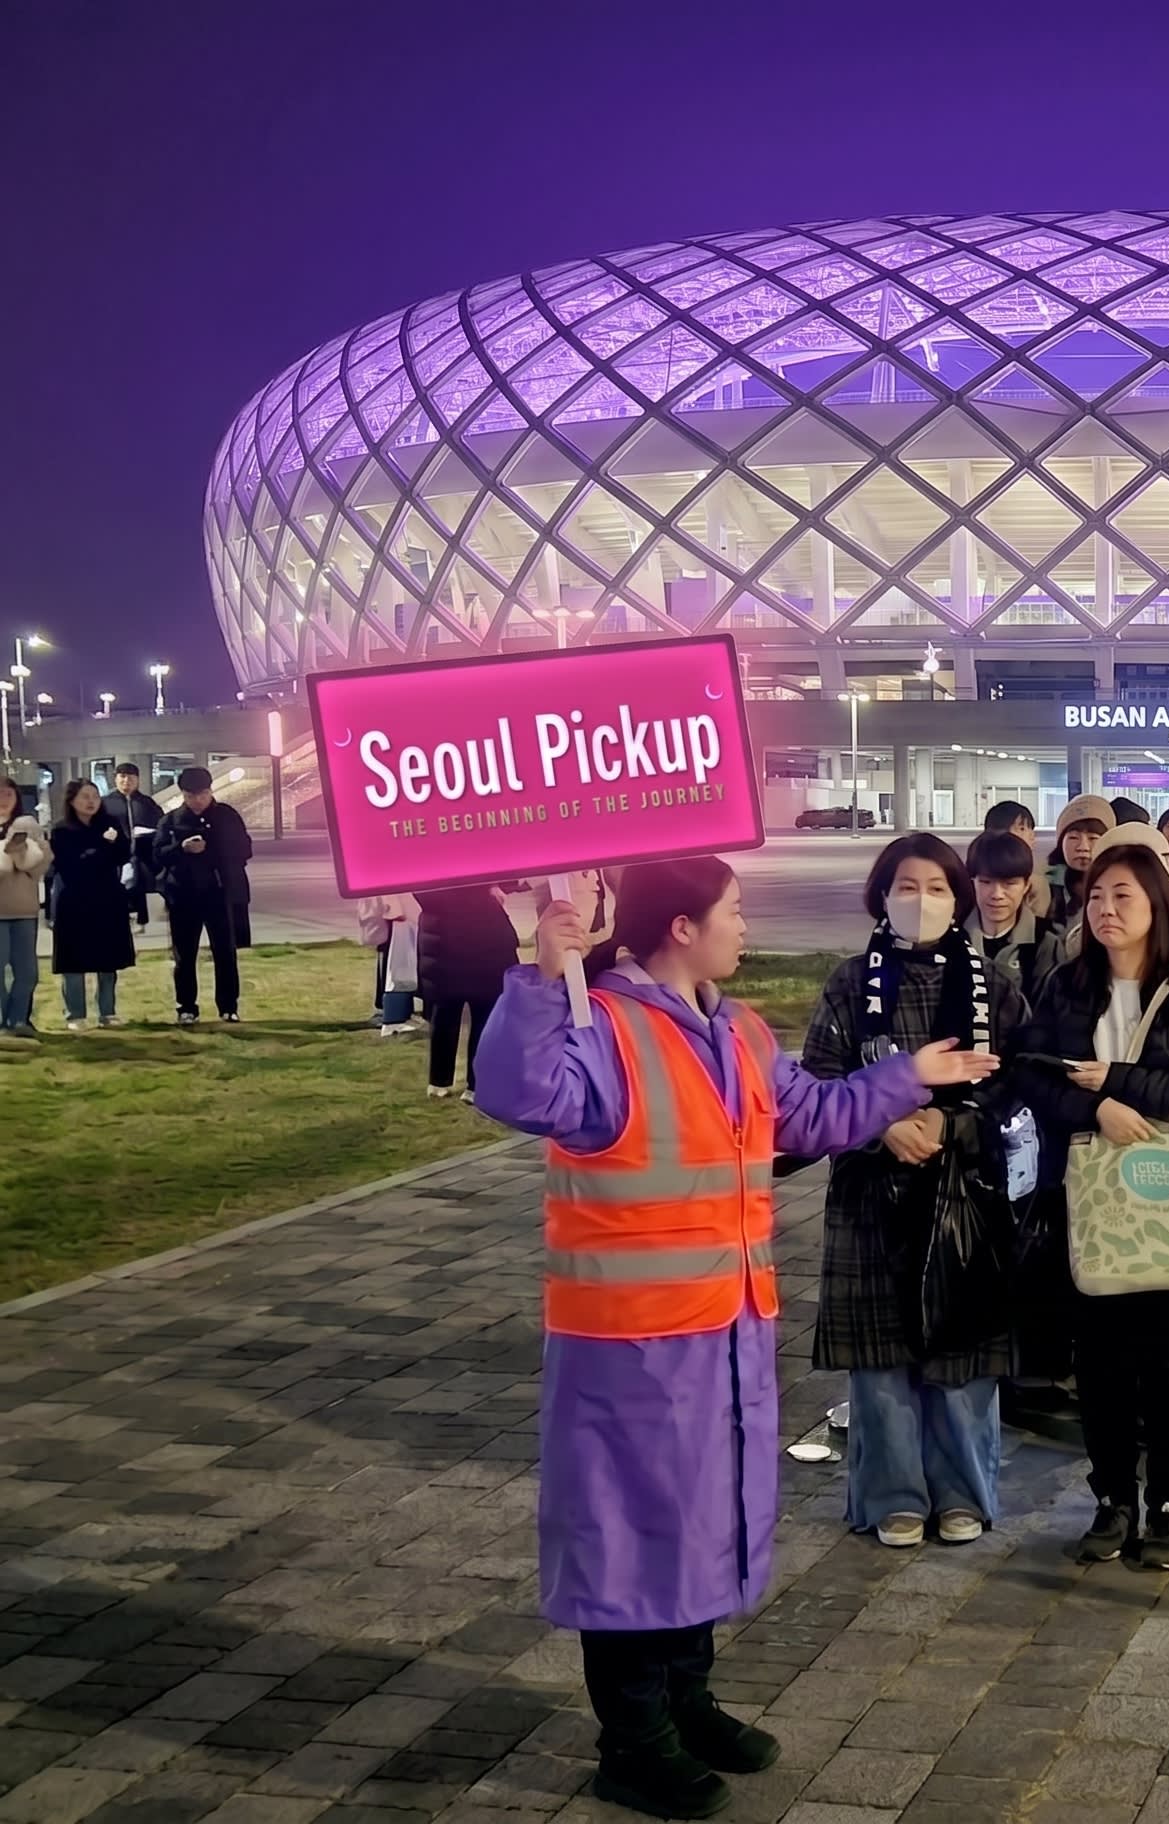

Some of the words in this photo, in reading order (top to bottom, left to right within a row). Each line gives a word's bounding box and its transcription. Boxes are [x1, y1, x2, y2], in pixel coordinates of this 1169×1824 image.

[1065, 705, 1146, 728] BUSAN
[359, 717, 524, 808] Seoul
[535, 704, 721, 785] Pickup
[389, 818, 427, 838] THE
[438, 804, 547, 833] BEGINNING
[559, 800, 581, 818] OF
[592, 794, 630, 814] THE
[641, 784, 725, 808] JOURNEY
